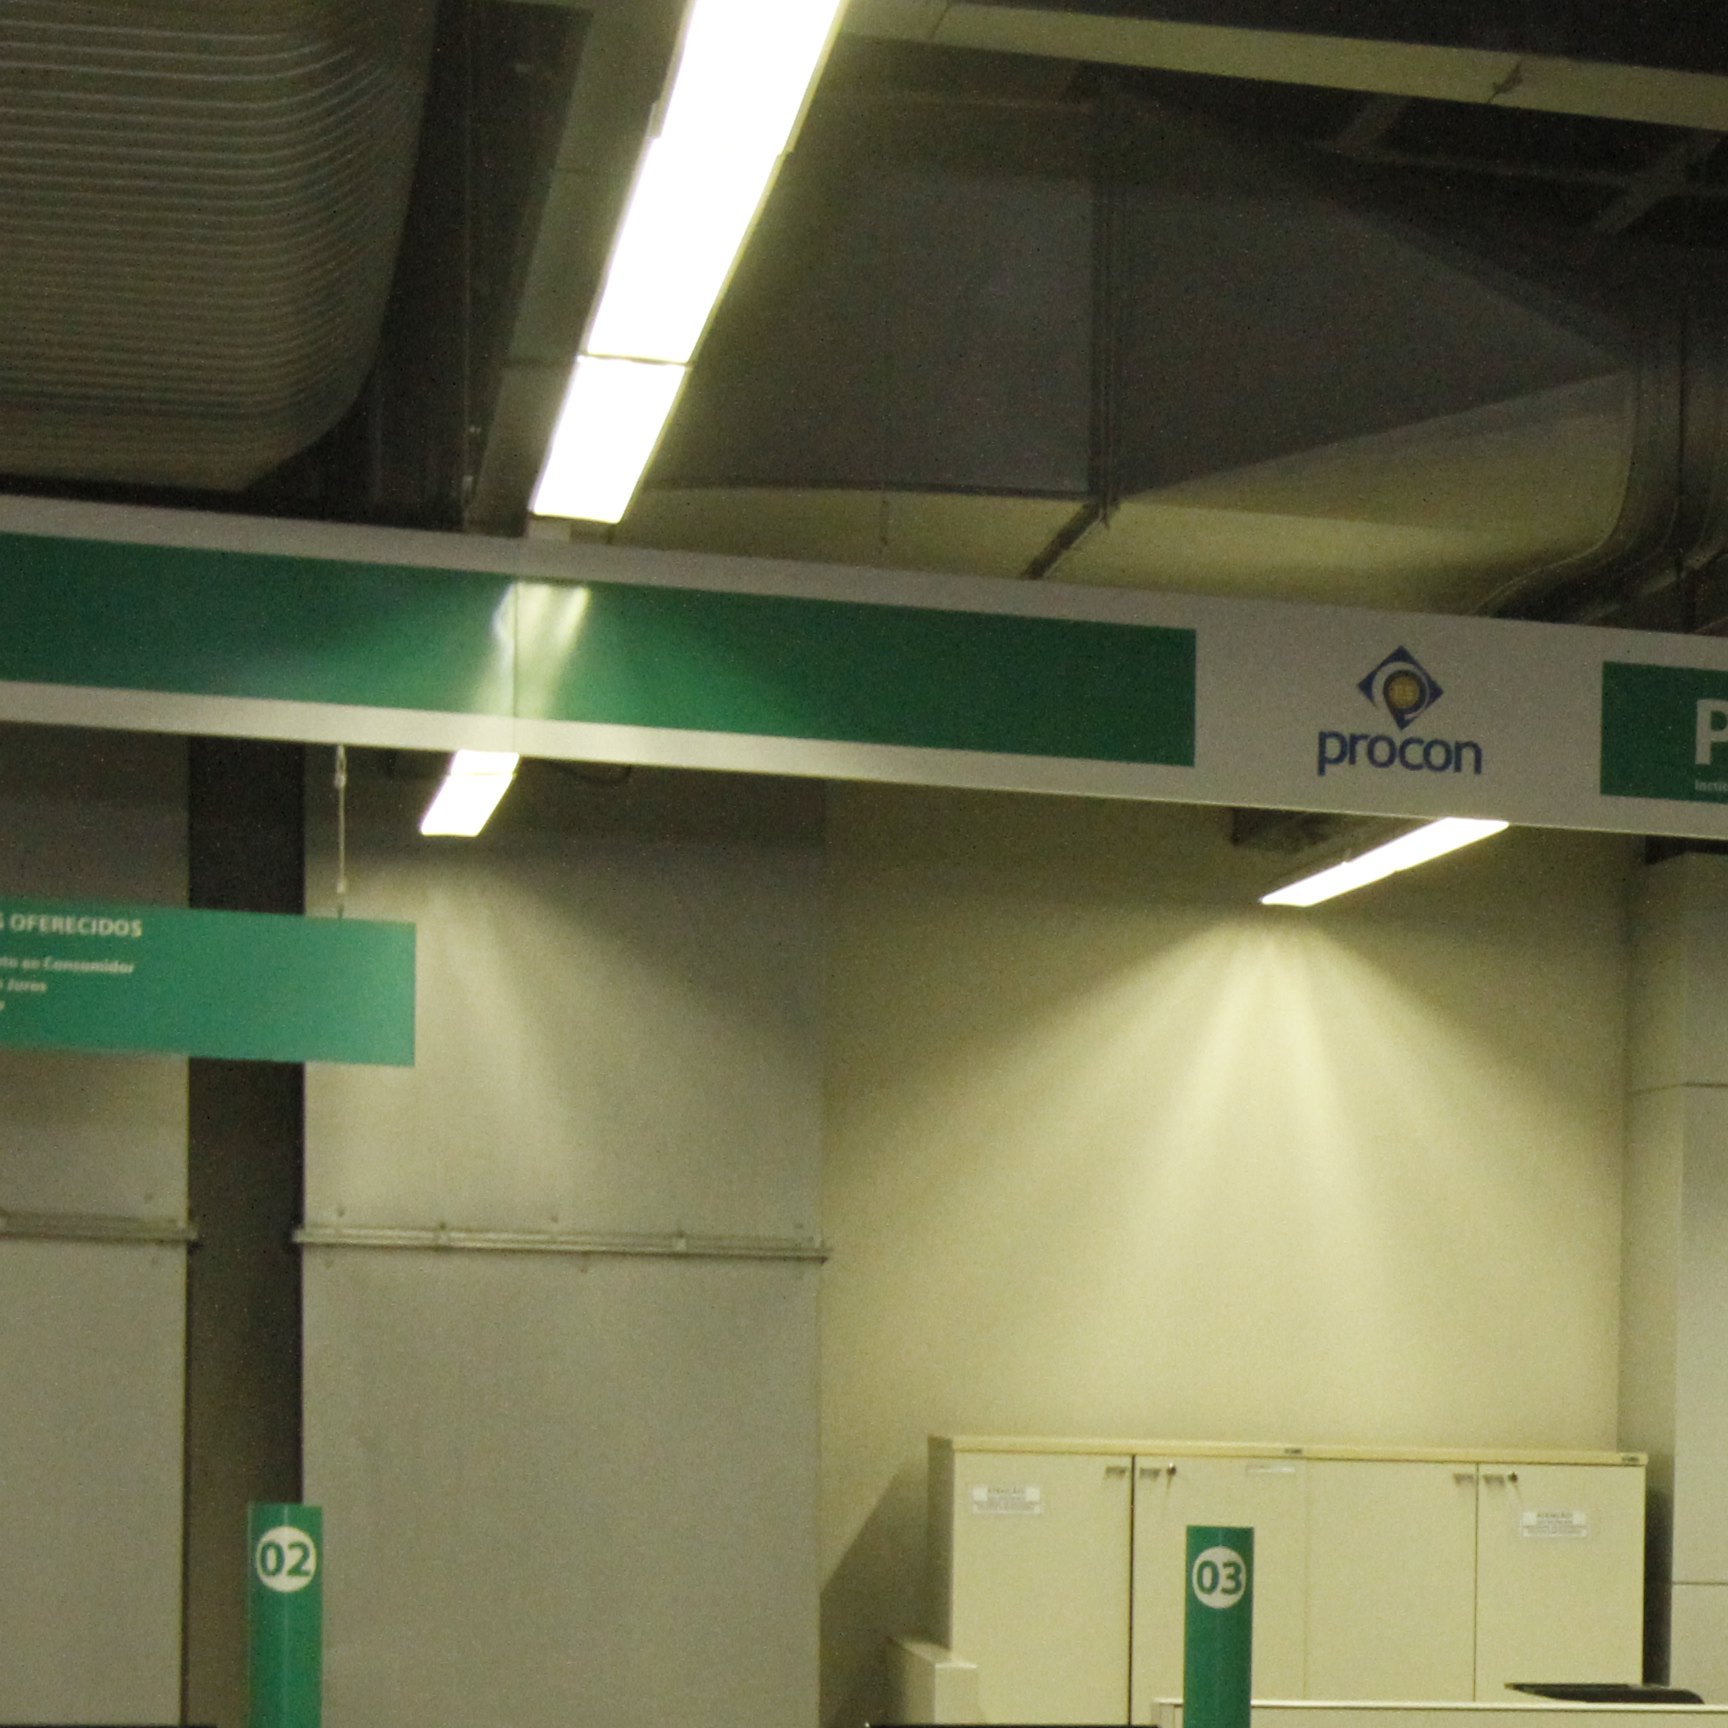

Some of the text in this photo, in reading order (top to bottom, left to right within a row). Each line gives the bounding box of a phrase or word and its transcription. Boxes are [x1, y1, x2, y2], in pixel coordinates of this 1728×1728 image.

[1317, 730, 1483, 776] procon
[10, 913, 144, 937] OFERECIDOS
[259, 1540, 311, 1577] 02
[1196, 1559, 1243, 1596] 03
